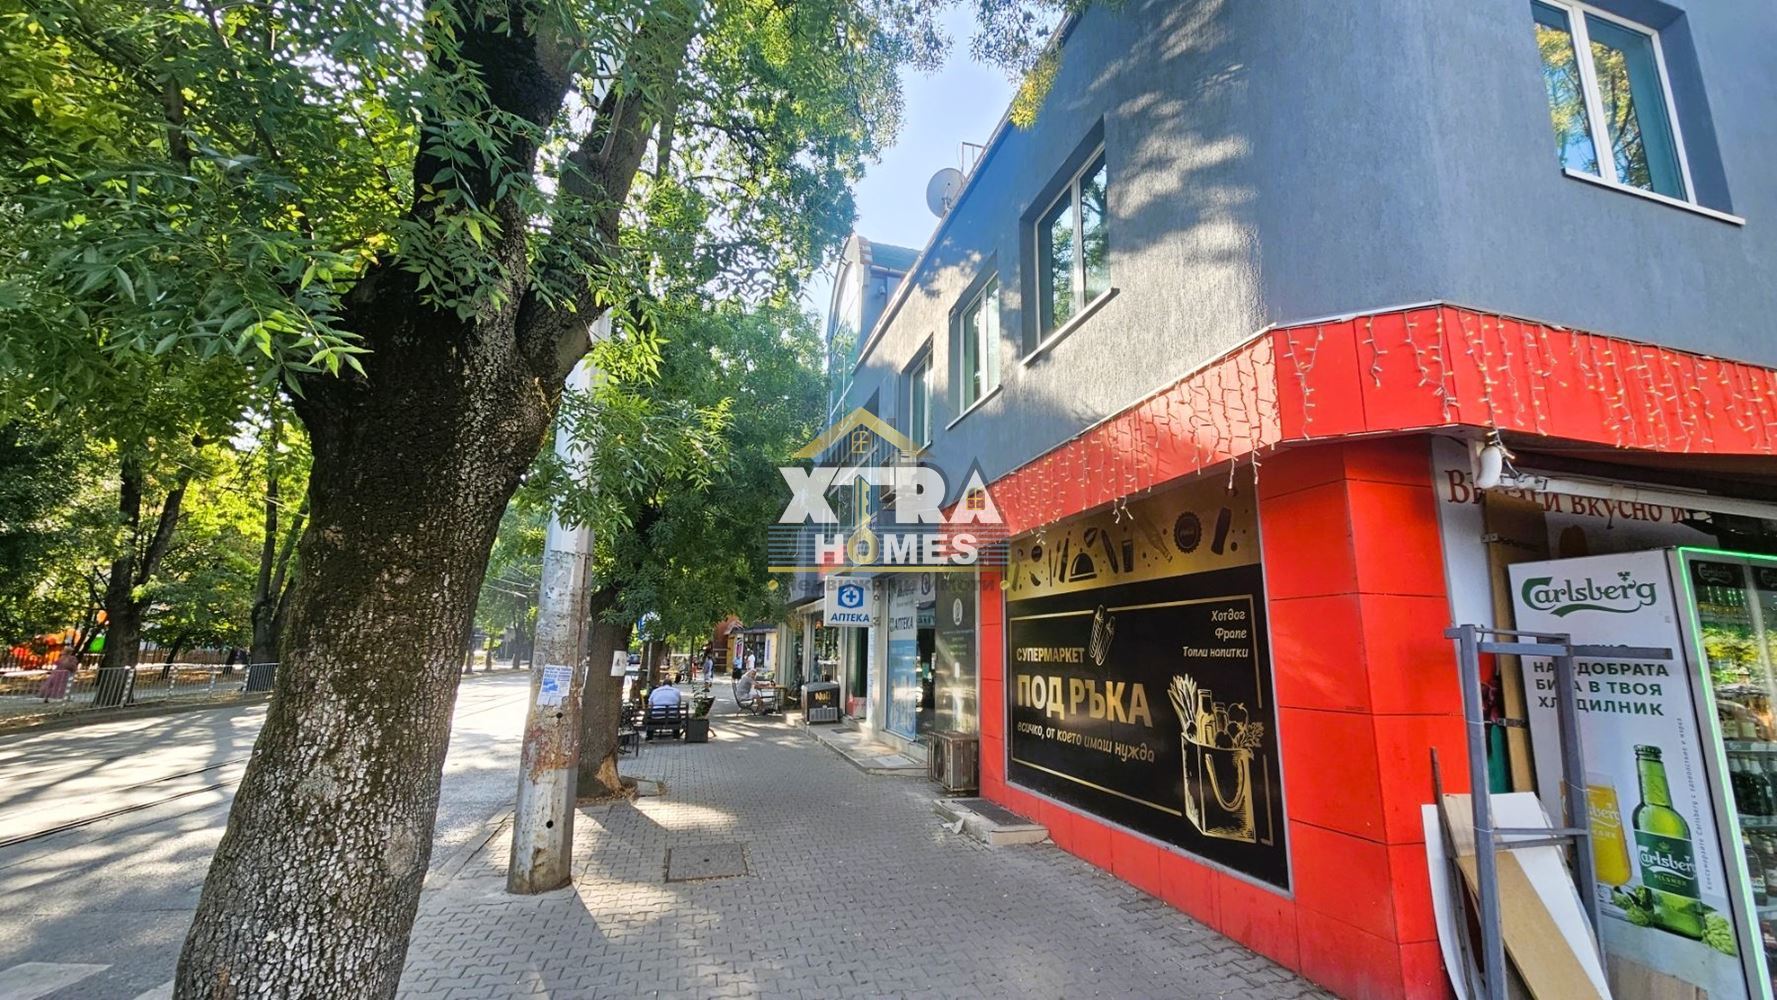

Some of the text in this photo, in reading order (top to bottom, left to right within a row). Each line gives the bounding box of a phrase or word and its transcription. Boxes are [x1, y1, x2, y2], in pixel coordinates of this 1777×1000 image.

[1521, 574, 1658, 614] Carlsberg
[831, 612, 870, 622] АПТЕКА
[1211, 608, 1246, 622] Хотдог
[1214, 627, 1247, 642] Фрапе
[1016, 647, 1085, 663] СУПЕРМАРКЕТ
[1183, 646, 1249, 658] Топли напитки
[1533, 661, 1670, 677] НА-ДОБРАТА
[1536, 679, 1663, 696] БИА В ТВОЯ
[1017, 674, 1153, 729] ПОД РЪКА
[1538, 696, 1665, 717] ХЛДИЛНИК
[1046, 727, 1055, 739] от
[1057, 729, 1082, 745] което
[1084, 735, 1112, 753] имаш
[1115, 741, 1155, 763] нужда
